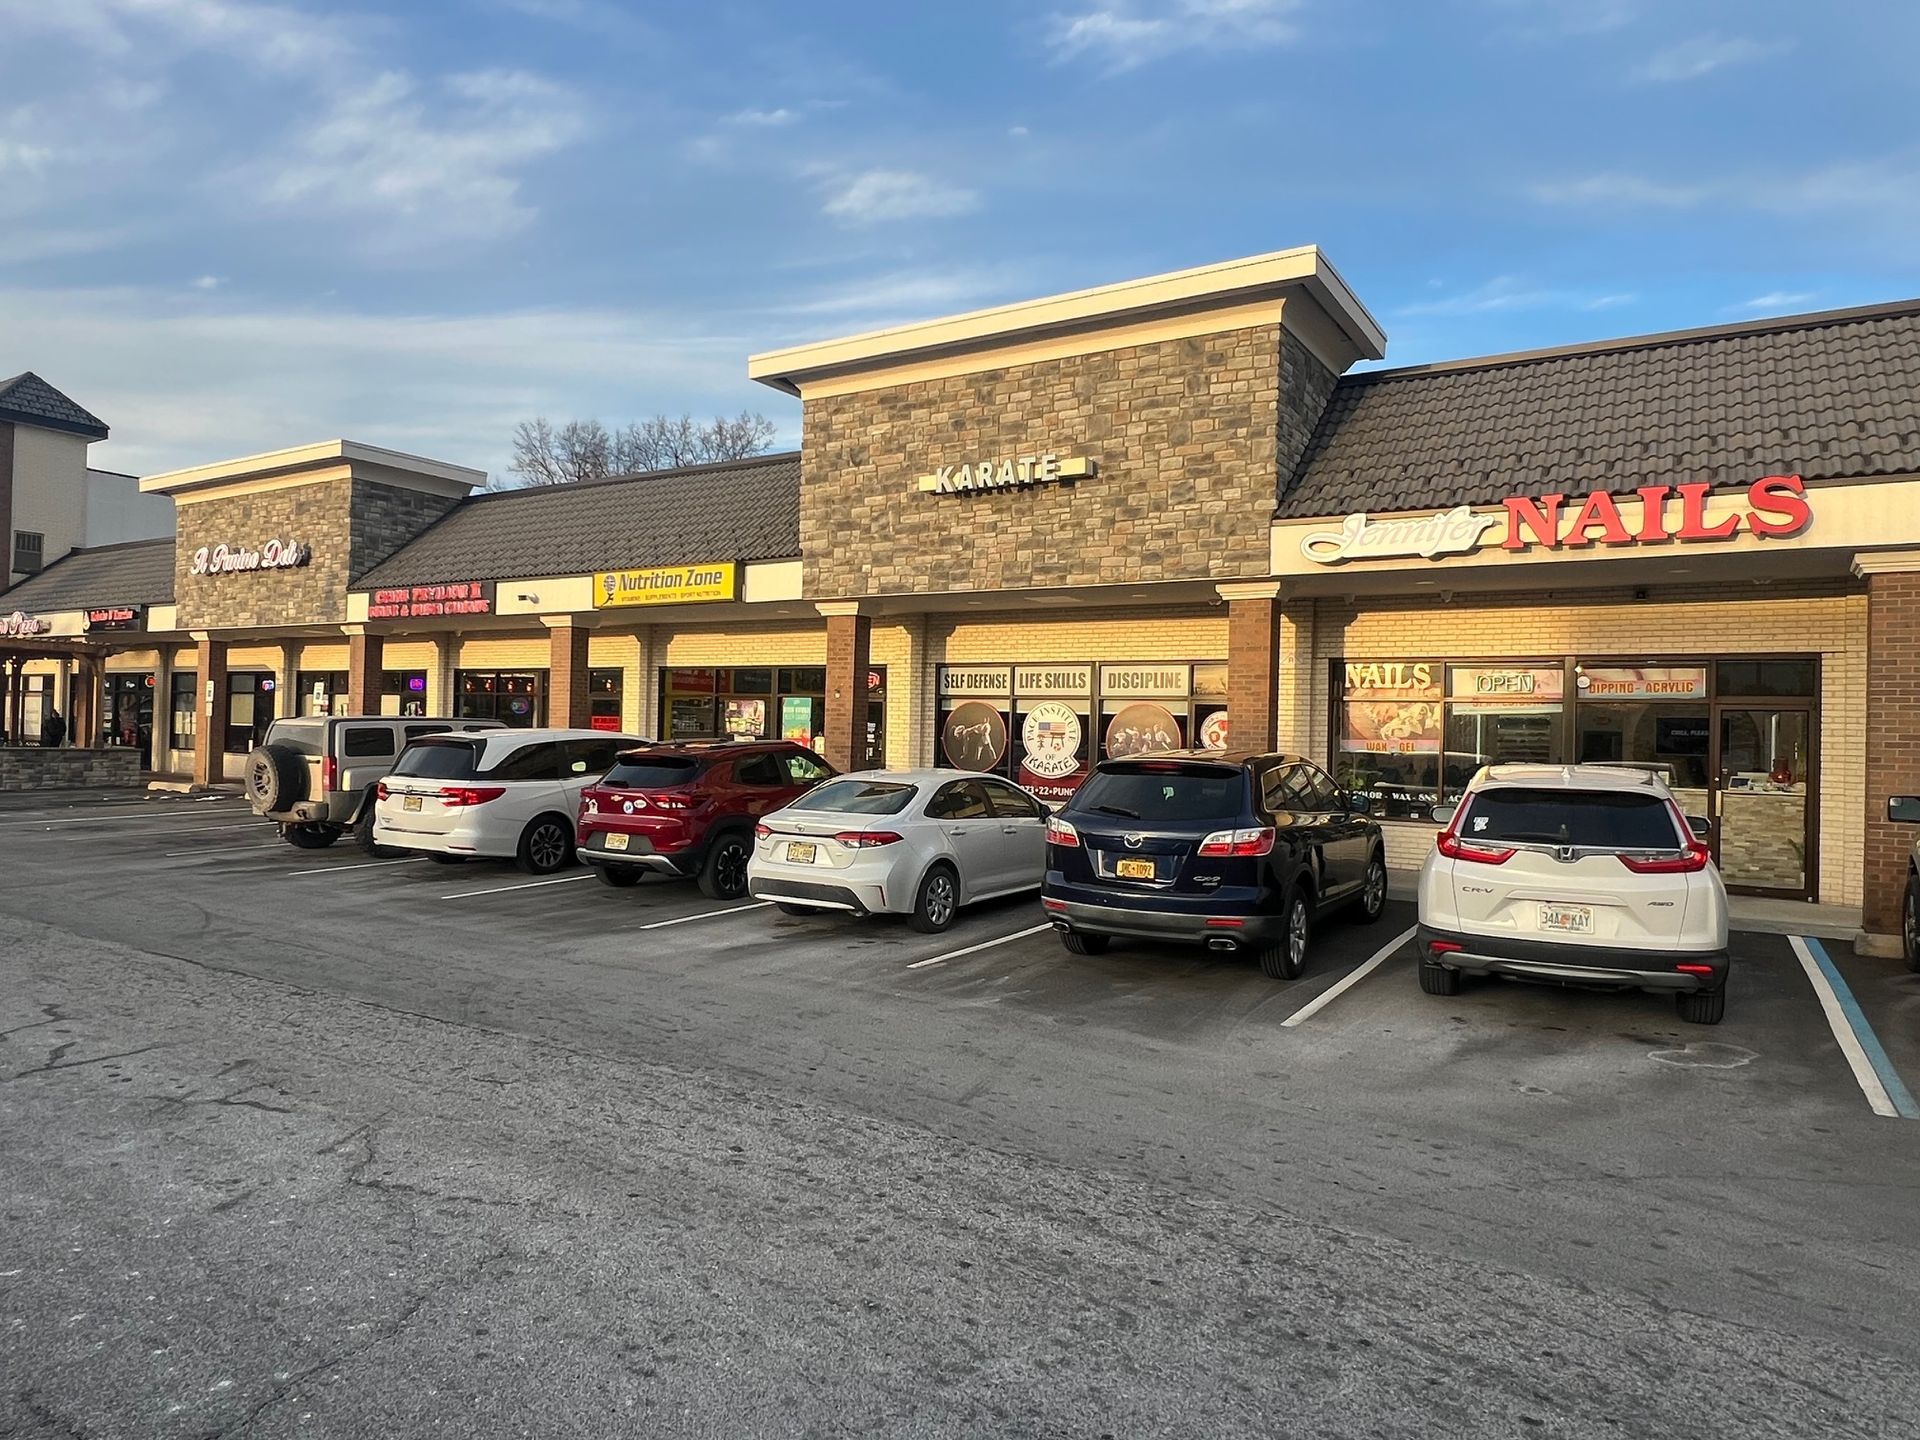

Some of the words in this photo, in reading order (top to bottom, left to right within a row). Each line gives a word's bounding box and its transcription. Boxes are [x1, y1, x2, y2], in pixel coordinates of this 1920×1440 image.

[935, 454, 1059, 494] KARATE
[1301, 505, 1495, 563] Jennifer
[1502, 475, 1811, 549] NAILS
[619, 571, 683, 592] Nutrition
[685, 568, 723, 588] Zone
[944, 673, 965, 689] SELF
[967, 673, 1007, 689] DEFENSE
[1019, 672, 1042, 689] LIFE
[1046, 671, 1087, 689] SKILLS
[1108, 671, 1182, 689] DISCIPLINE
[1345, 662, 1432, 690] NAILS
[1476, 673, 1535, 693] OPEN
[1645, 682, 1694, 693] ACRYLIC
[1366, 742, 1387, 752] WAX
[1399, 742, 1416, 752] GEL
[1029, 757, 1072, 773] KARATE
[1045, 753, 1056, 761] OF
[1392, 792, 1411, 801] WAX
[1418, 793, 1438, 802] SNS
[1462, 886, 1494, 894] CR-V
